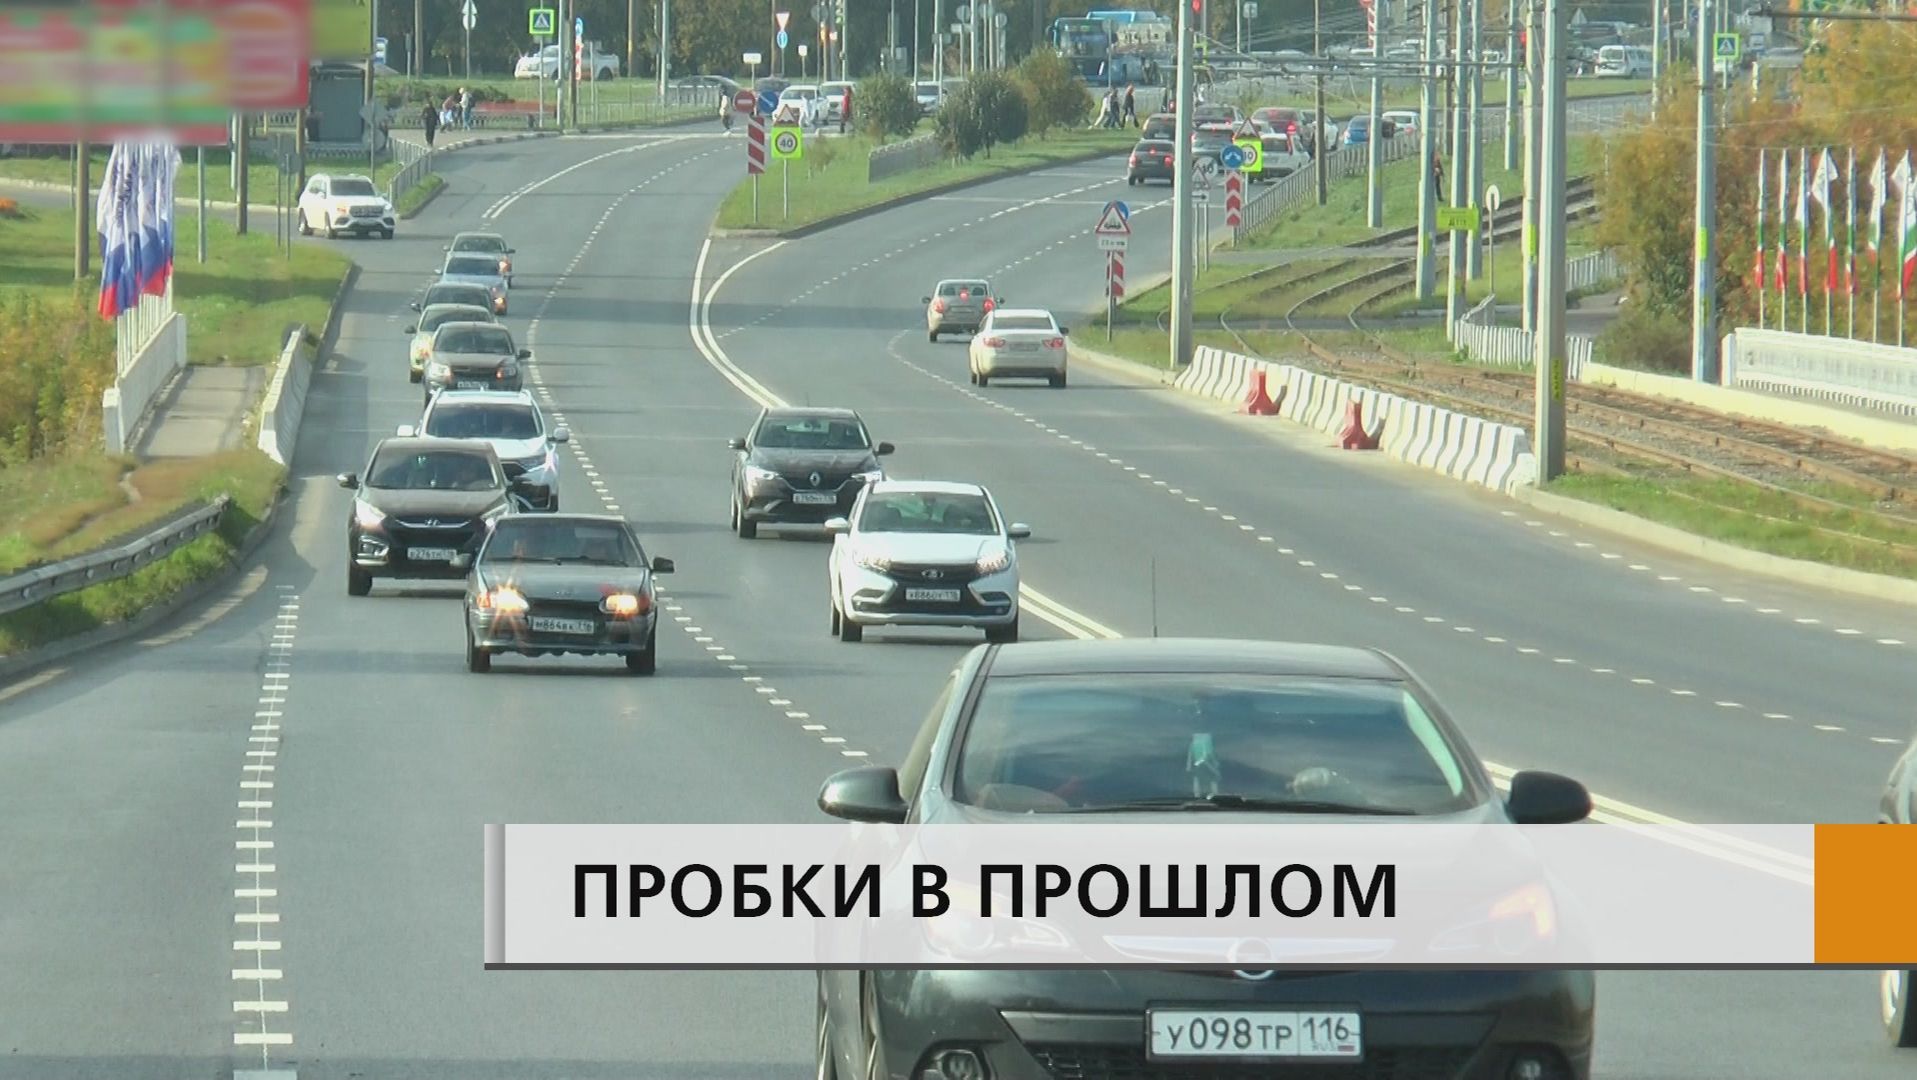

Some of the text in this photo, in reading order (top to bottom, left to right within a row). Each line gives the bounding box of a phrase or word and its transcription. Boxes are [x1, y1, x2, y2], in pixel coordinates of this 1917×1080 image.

[779, 137, 794, 148] 40
[1167, 1016, 1350, 1050] У098ТР 116
